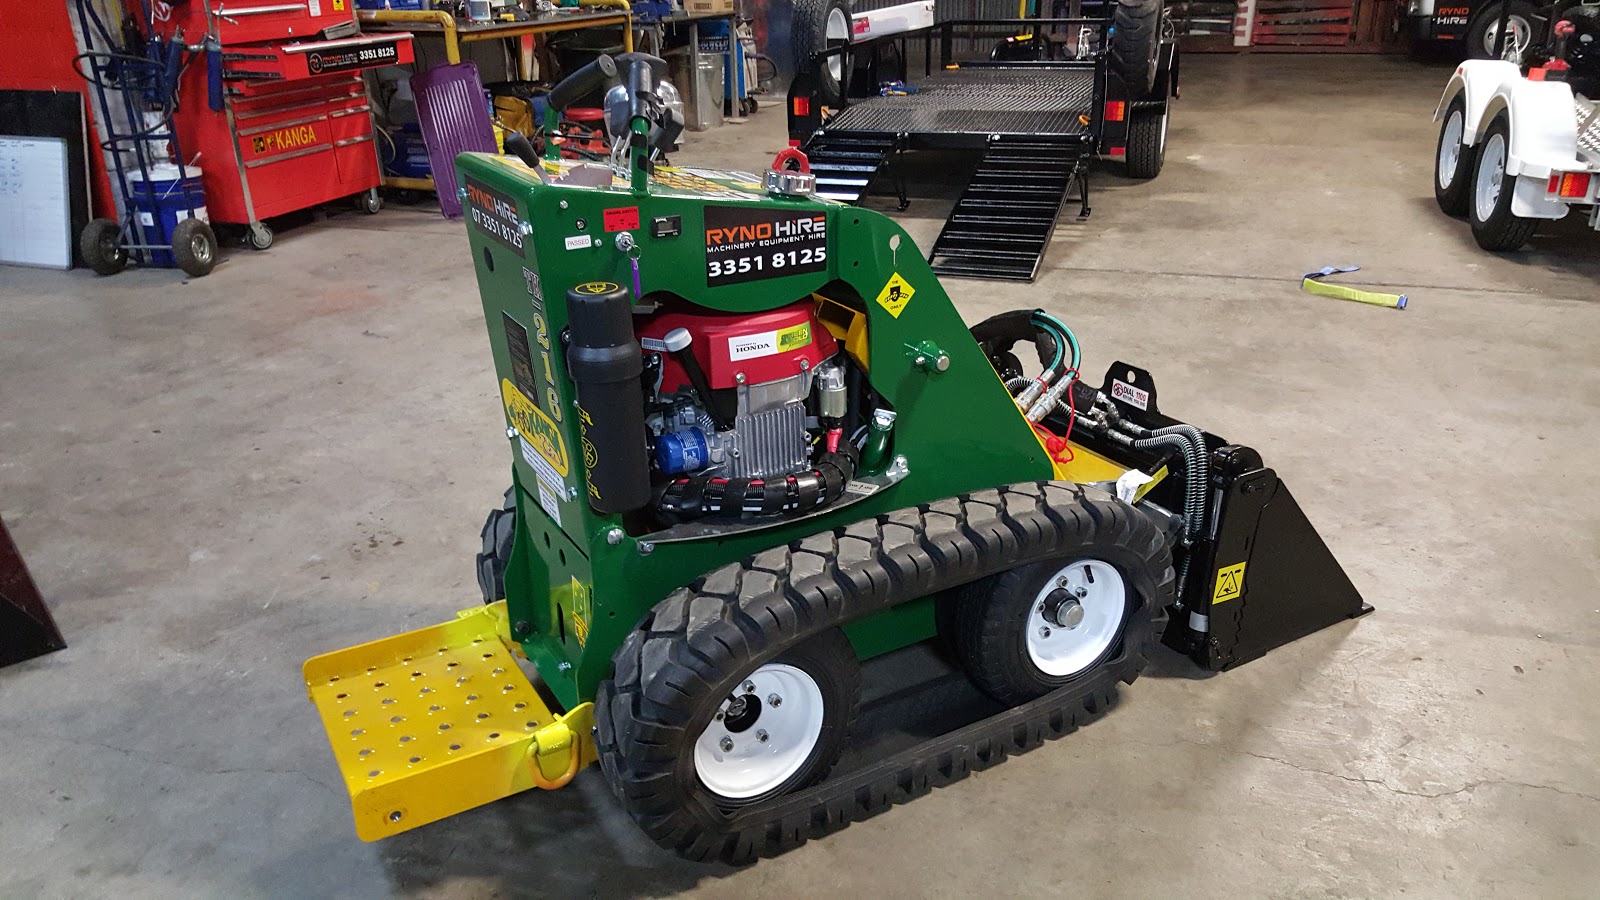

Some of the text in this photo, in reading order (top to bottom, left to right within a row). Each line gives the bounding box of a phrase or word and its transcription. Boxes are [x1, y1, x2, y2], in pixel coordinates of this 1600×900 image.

[1439, 7, 1470, 15] RYNO
[359, 49, 377, 60] 3351
[377, 47, 395, 58] 8125
[275, 125, 316, 150] KANGA
[467, 184, 495, 213] RYNO
[471, 207, 523, 249] 07 3351 8125
[706, 223, 772, 246] RYNO
[567, 238, 590, 247] PASSED
[706, 232, 826, 254] MACHINERY EQUIPMENT HIRE
[708, 247, 827, 277] 3351 8125
[736, 343, 770, 353] HONDA
[1123, 386, 1147, 402] DIAL 1100
